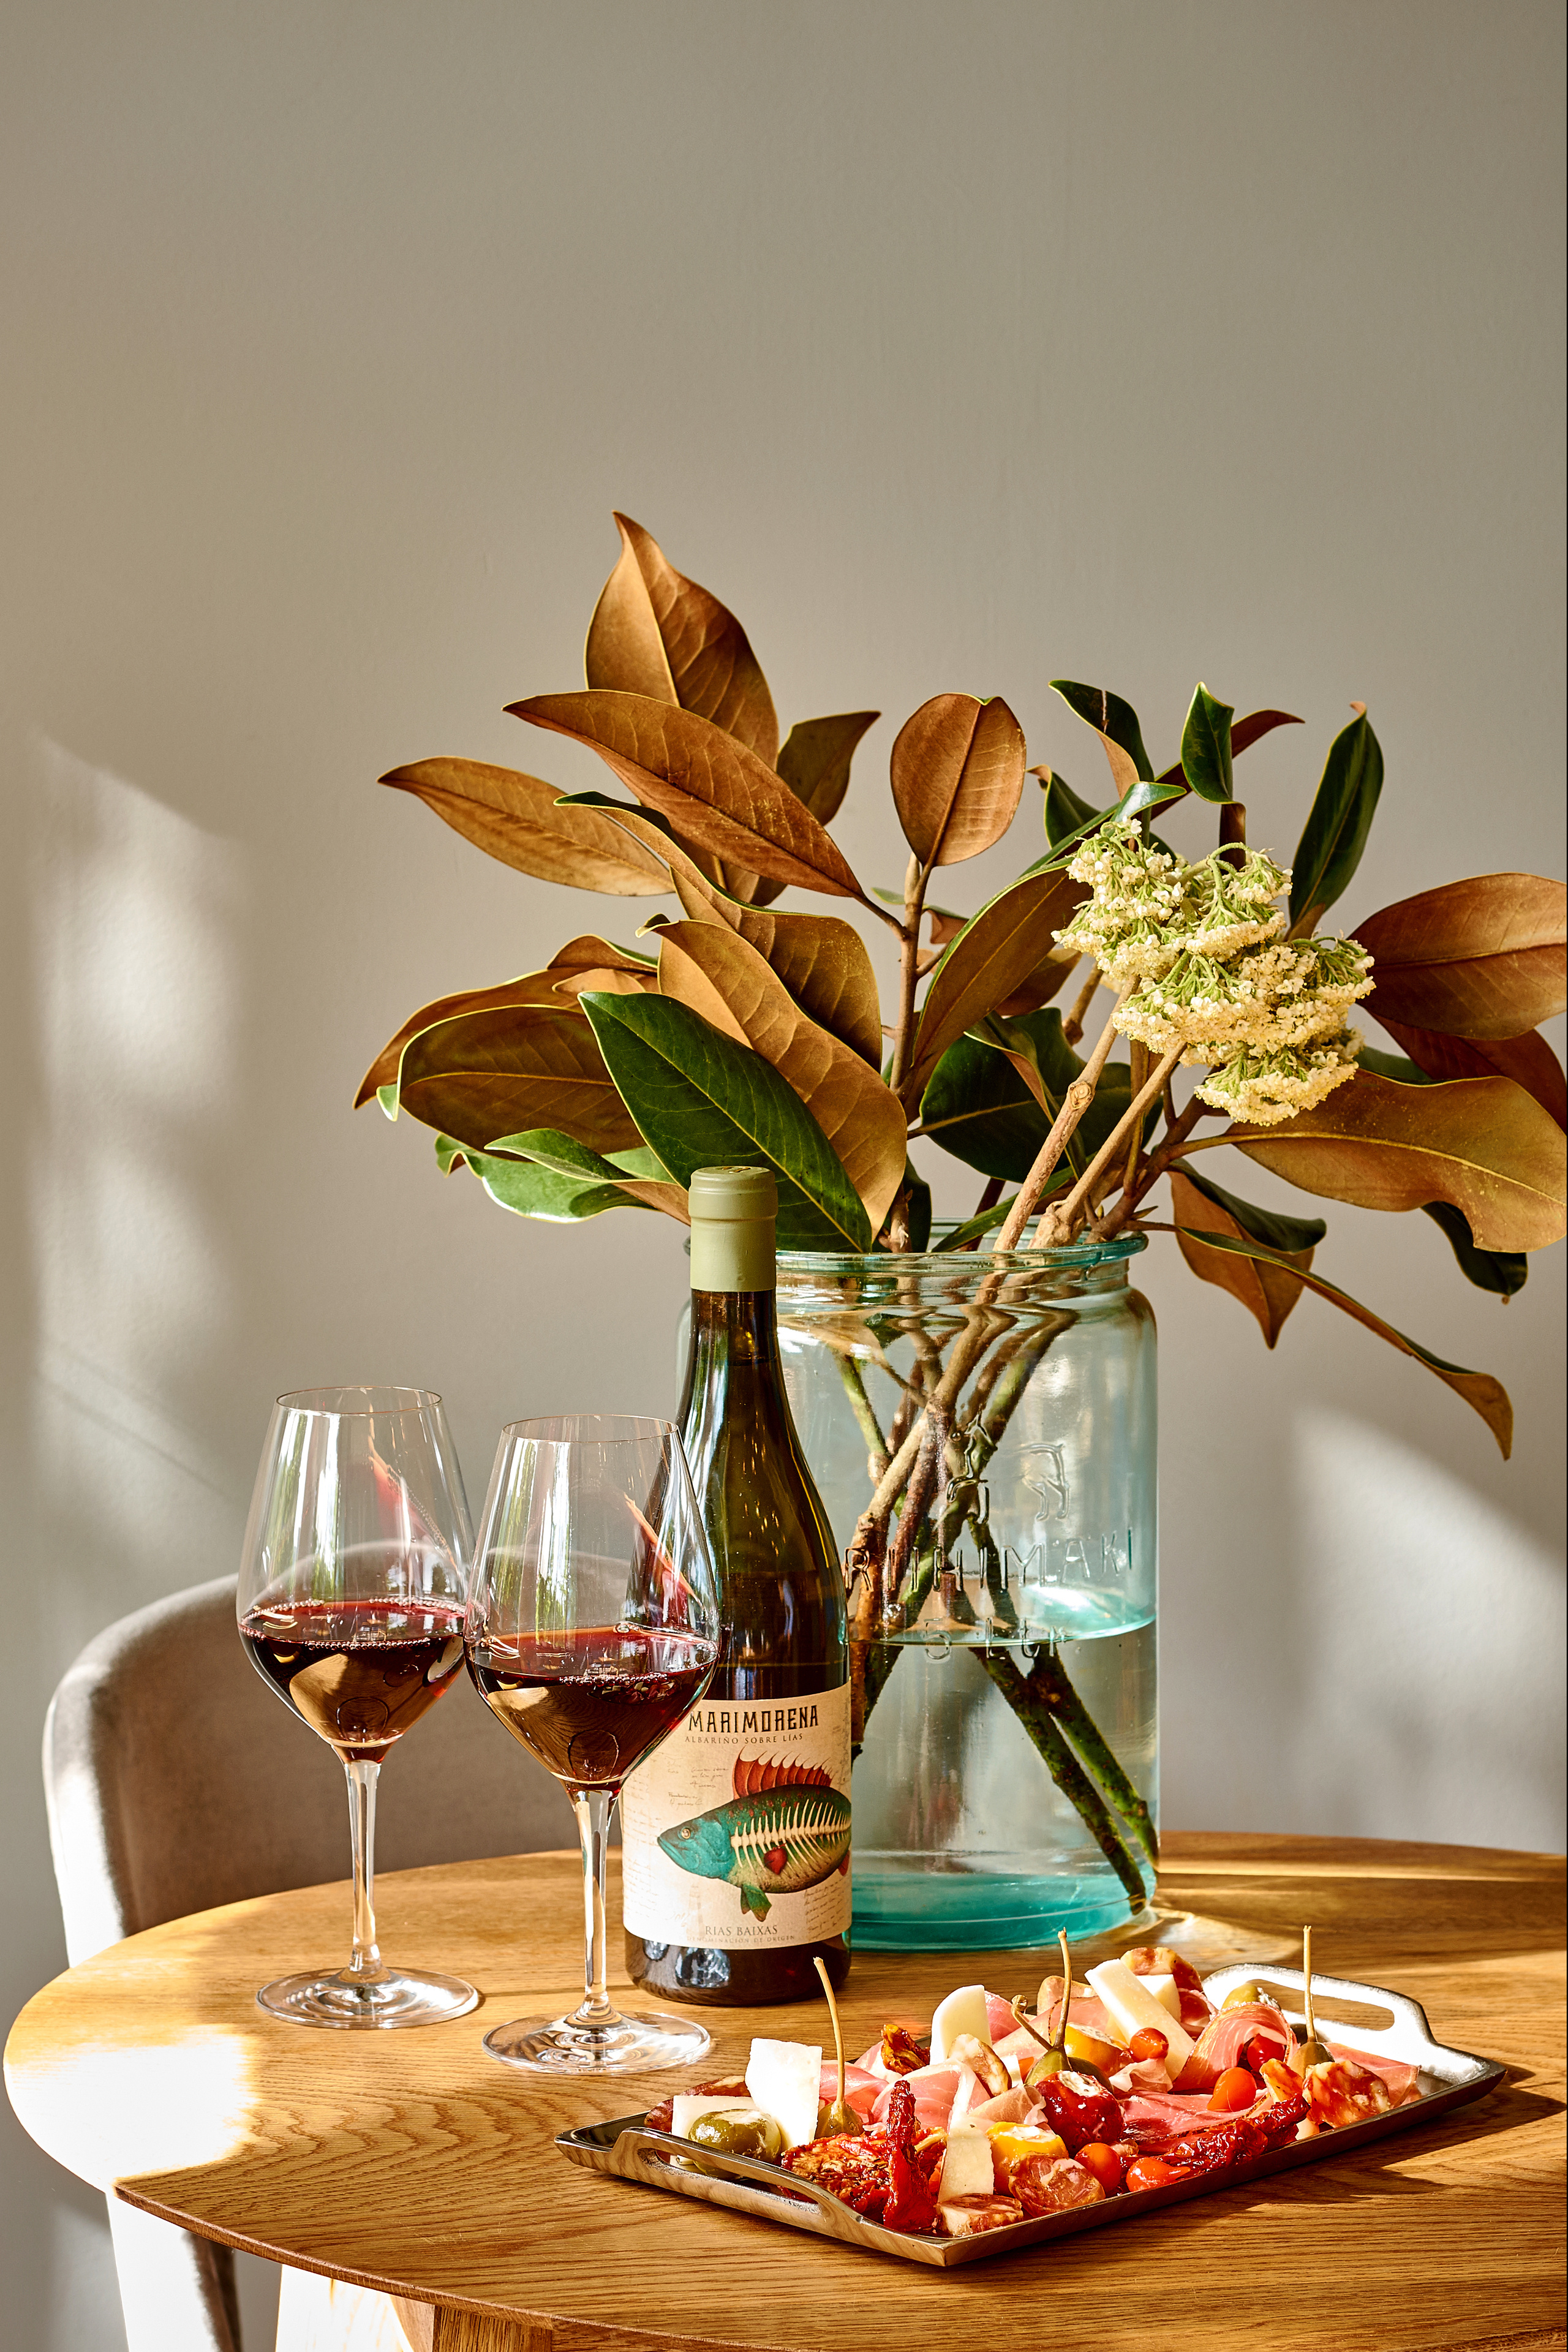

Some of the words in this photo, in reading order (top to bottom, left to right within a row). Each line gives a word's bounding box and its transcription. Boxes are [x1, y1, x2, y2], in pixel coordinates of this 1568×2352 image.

[689, 1705, 818, 1733] MARIMORENA
[685, 1736, 739, 1744] ALBARIÑO
[744, 1735, 777, 1744] SOBRE
[783, 1733, 804, 1742] LÍAS
[705, 1926, 732, 1936] RIAS
[737, 1925, 778, 1936] BAIXAS
